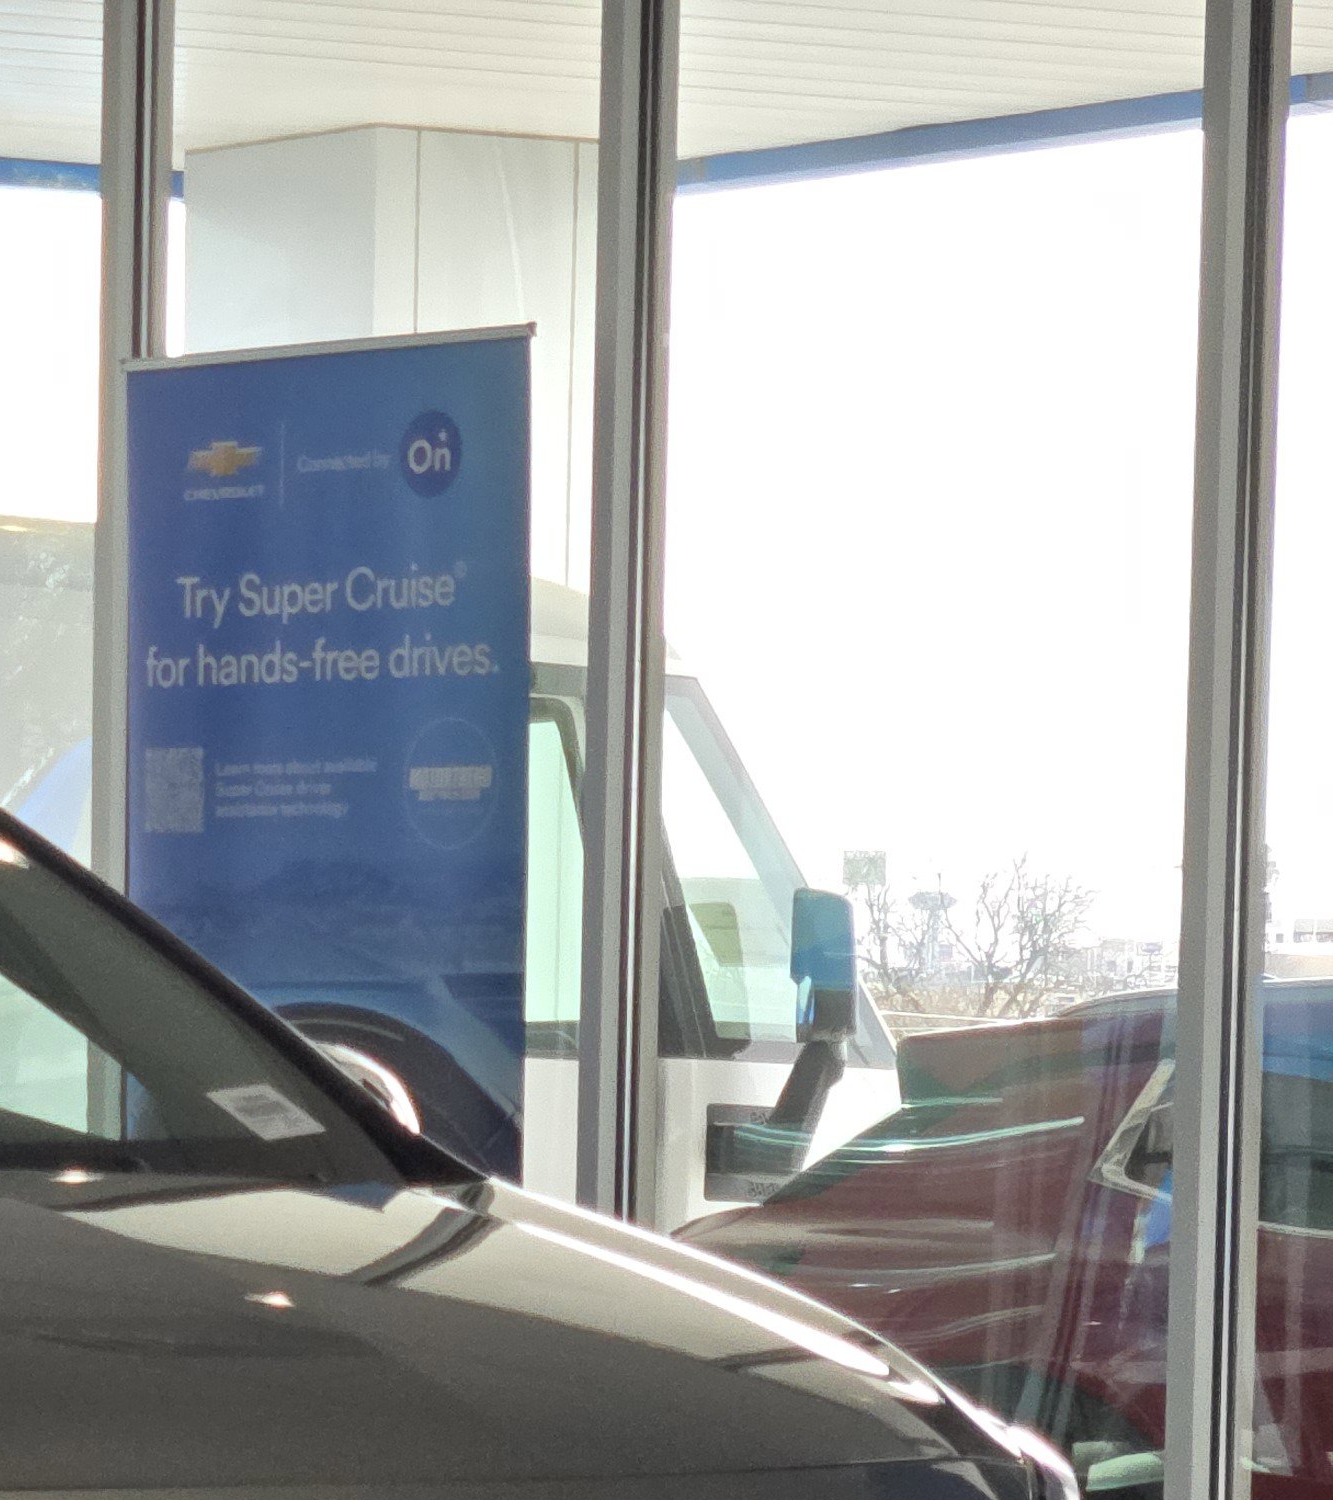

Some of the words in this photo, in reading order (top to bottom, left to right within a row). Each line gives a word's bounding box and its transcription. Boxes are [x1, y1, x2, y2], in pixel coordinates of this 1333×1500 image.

[184, 484, 265, 500] CHEVROLET
[176, 575, 231, 629] Try
[239, 571, 338, 625] Super
[146, 645, 190, 689] for
[197, 636, 381, 687] hands-free
[389, 632, 501, 679] drives.
